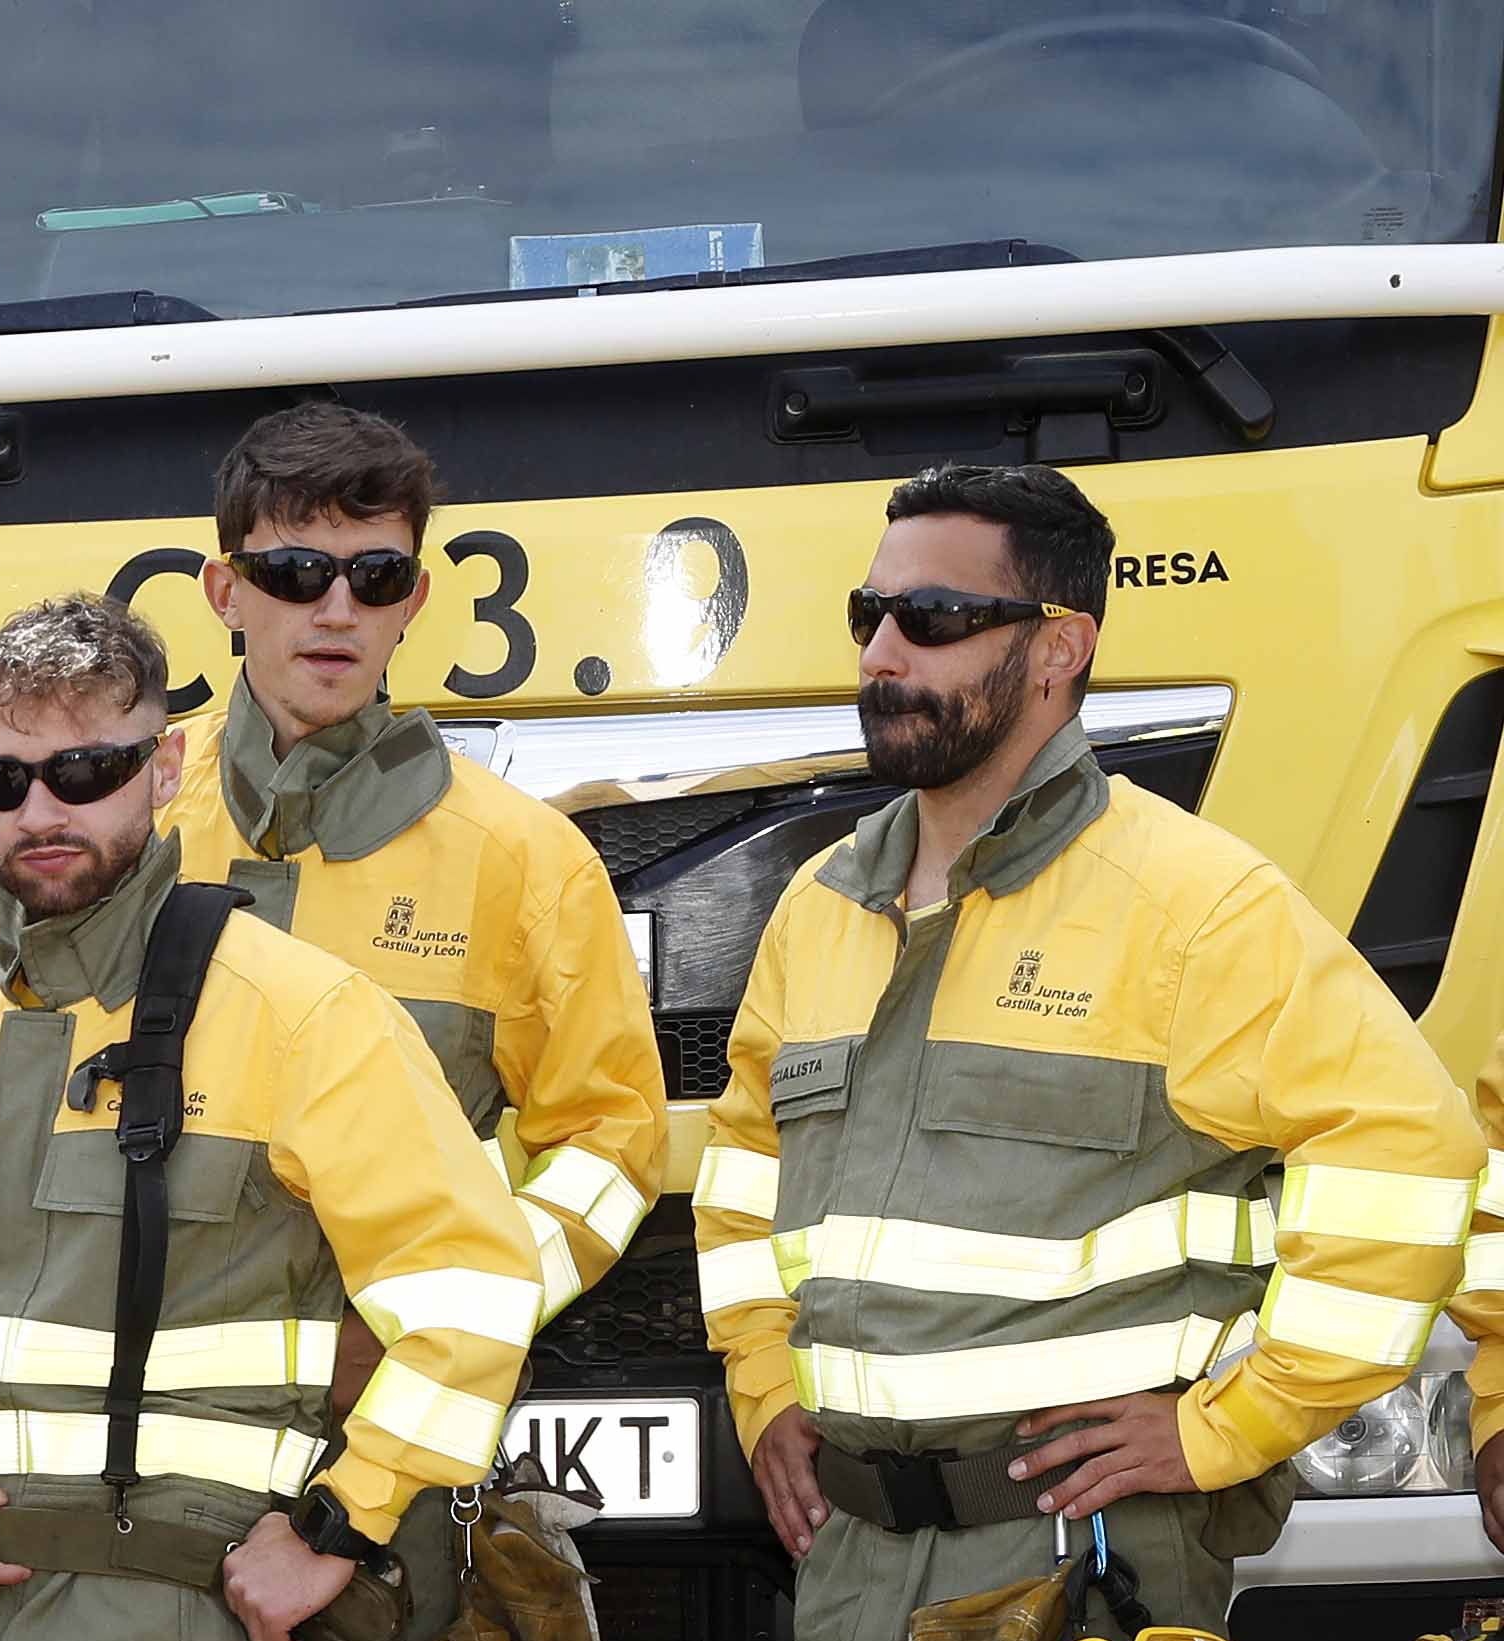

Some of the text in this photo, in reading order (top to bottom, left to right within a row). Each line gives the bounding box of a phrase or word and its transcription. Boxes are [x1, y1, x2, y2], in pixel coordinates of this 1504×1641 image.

[1114, 550, 1230, 588] RESA
[411, 930, 469, 943] Junta de
[372, 936, 466, 958] Castilla y León
[1033, 985, 1093, 1003] Junta de
[995, 996, 1088, 1017] Castilla y León
[188, 1091, 208, 1104] de
